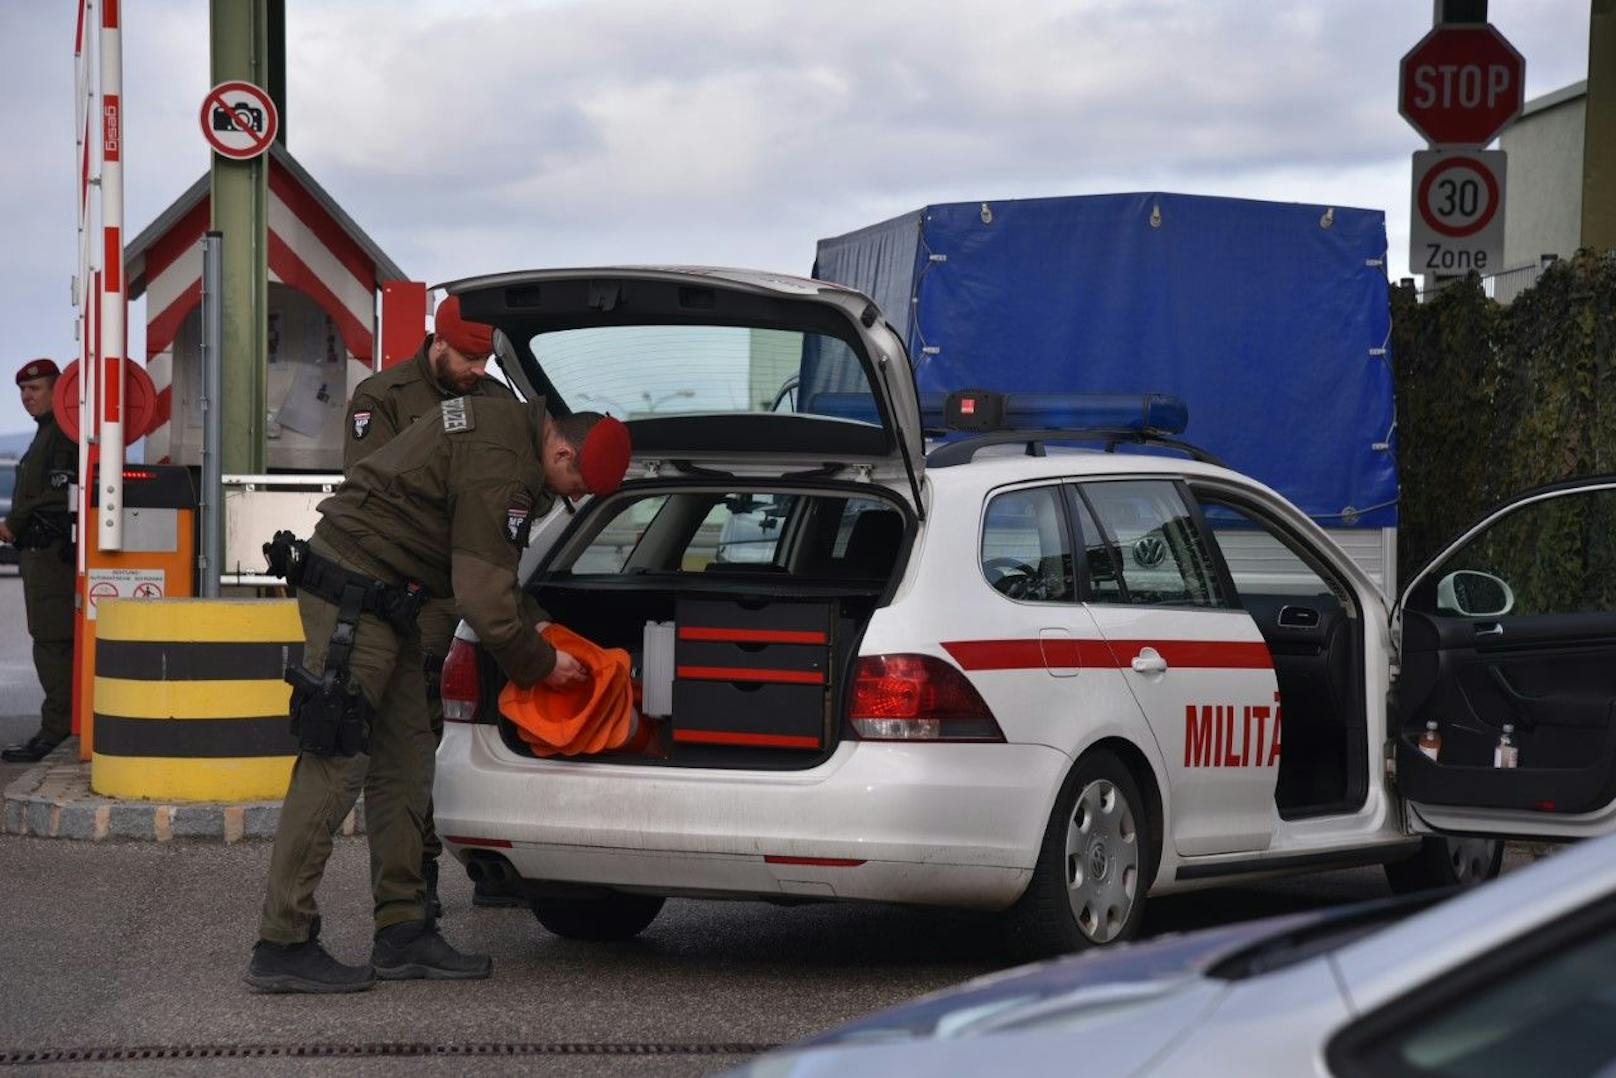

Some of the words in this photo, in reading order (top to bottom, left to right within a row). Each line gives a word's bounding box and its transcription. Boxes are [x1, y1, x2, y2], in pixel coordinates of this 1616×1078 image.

[1413, 64, 1510, 109] STOP
[1437, 179, 1479, 218] 30
[1426, 243, 1487, 270] Zone
[508, 517, 524, 526] MP
